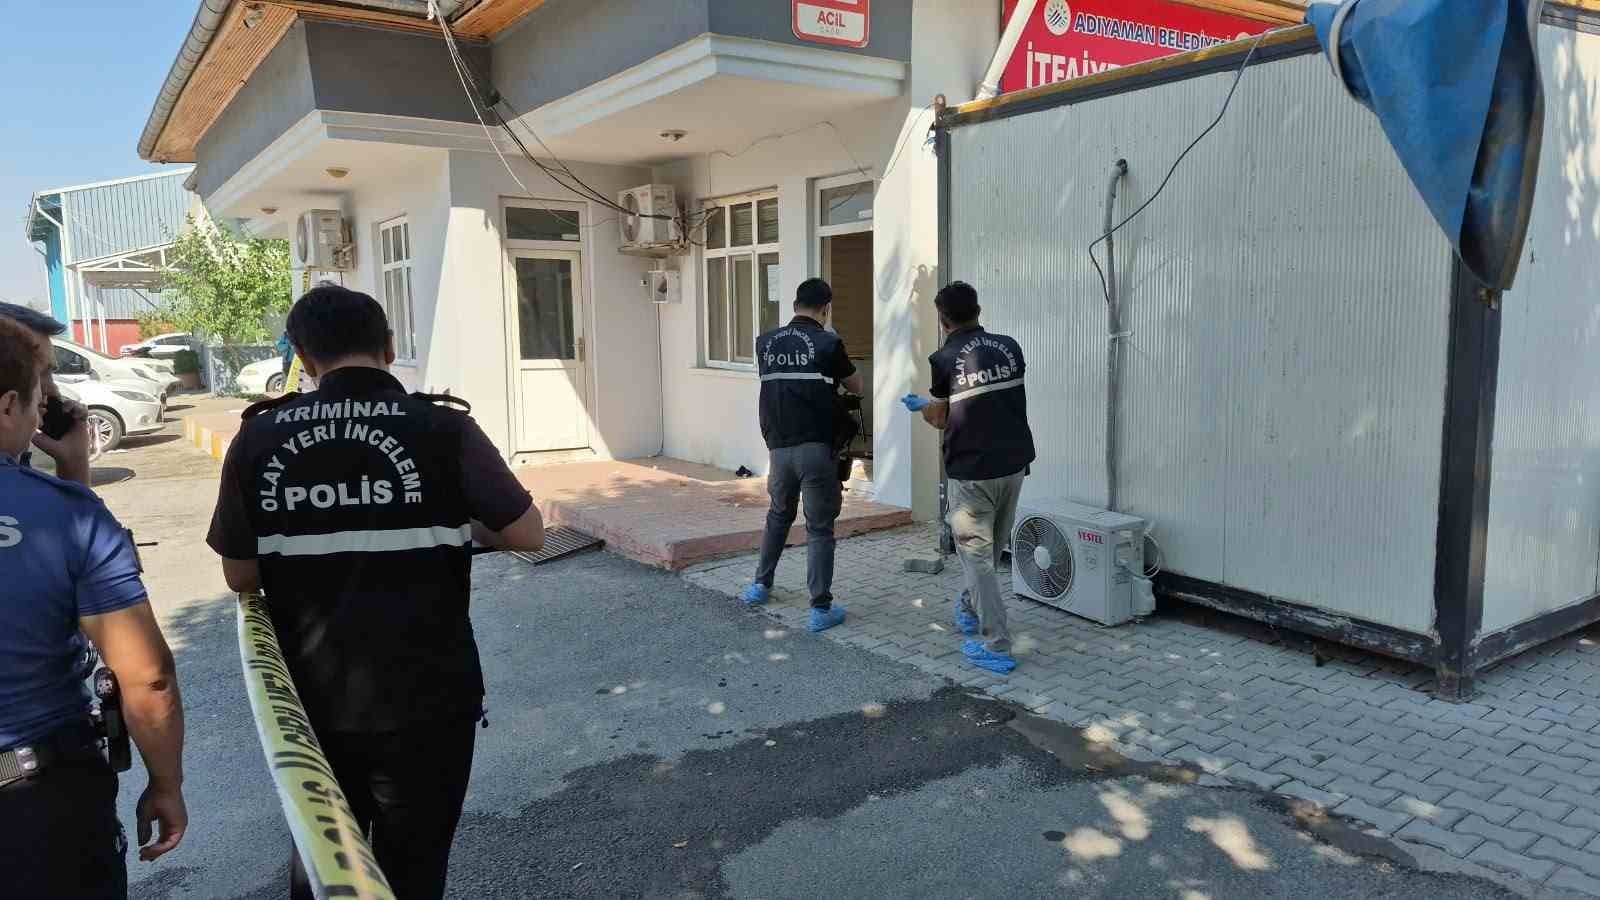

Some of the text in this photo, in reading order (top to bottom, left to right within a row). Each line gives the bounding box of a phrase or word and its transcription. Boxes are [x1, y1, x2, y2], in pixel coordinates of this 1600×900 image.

[1074, 12, 1155, 45] ADIYAMAN
[767, 350, 809, 367] POLİS
[966, 364, 1011, 387] POLİS
[275, 398, 407, 424] KRİMİNAL
[260, 418, 423, 512] OLAY YERİ İNCELEME
[284, 474, 393, 511] POLİS
